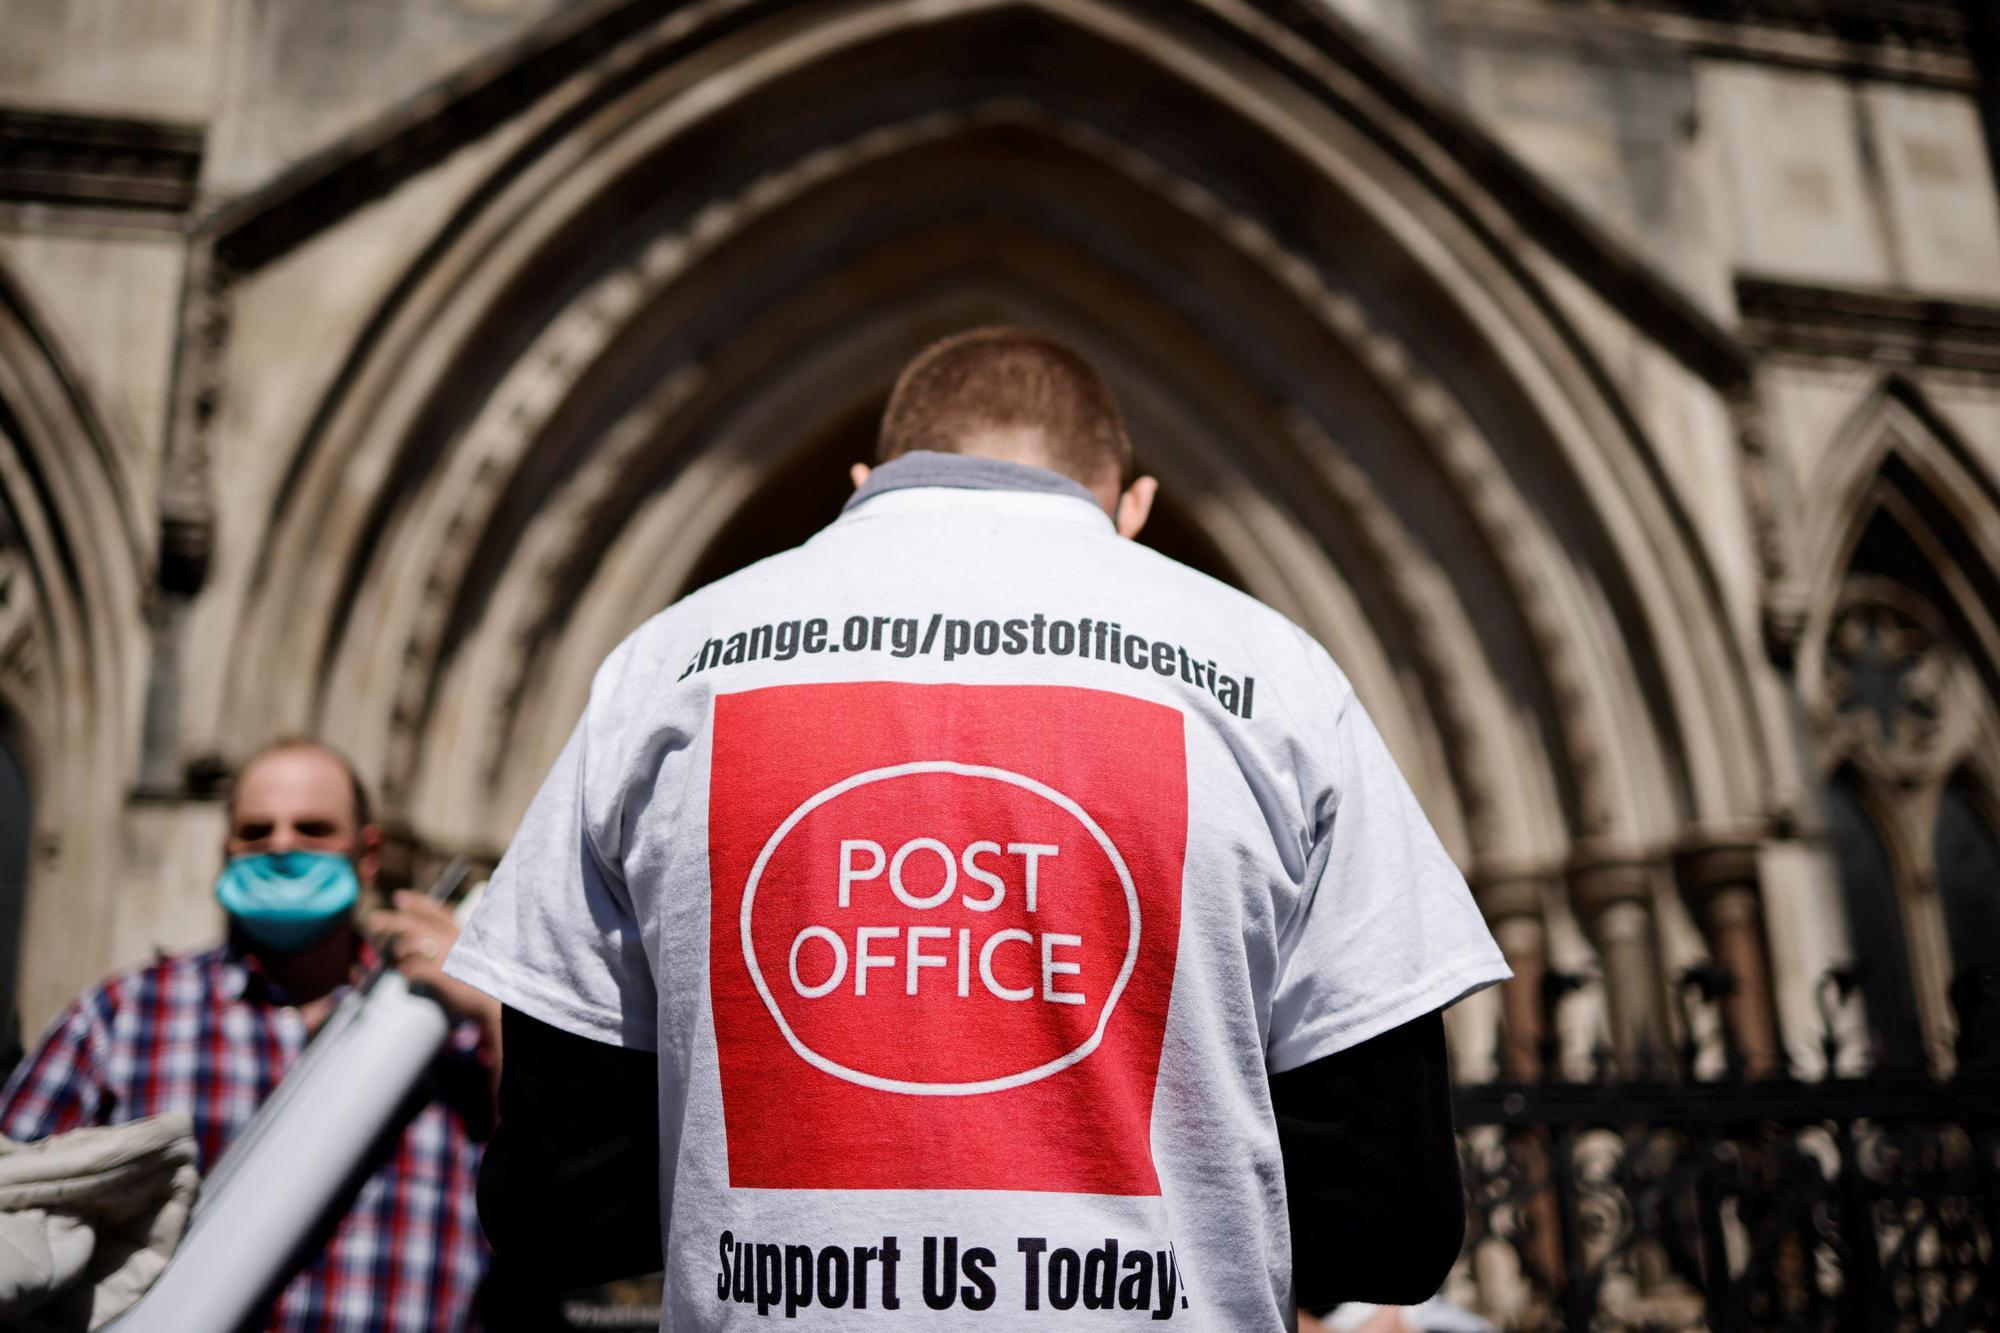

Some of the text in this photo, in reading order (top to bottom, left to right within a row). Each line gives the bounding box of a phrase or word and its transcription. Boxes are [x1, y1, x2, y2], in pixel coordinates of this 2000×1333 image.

[838, 837, 1060, 913] POST
[788, 925, 1087, 1005] OFFICE
[717, 1230, 901, 1318] Support
[922, 1236, 997, 1311] Us
